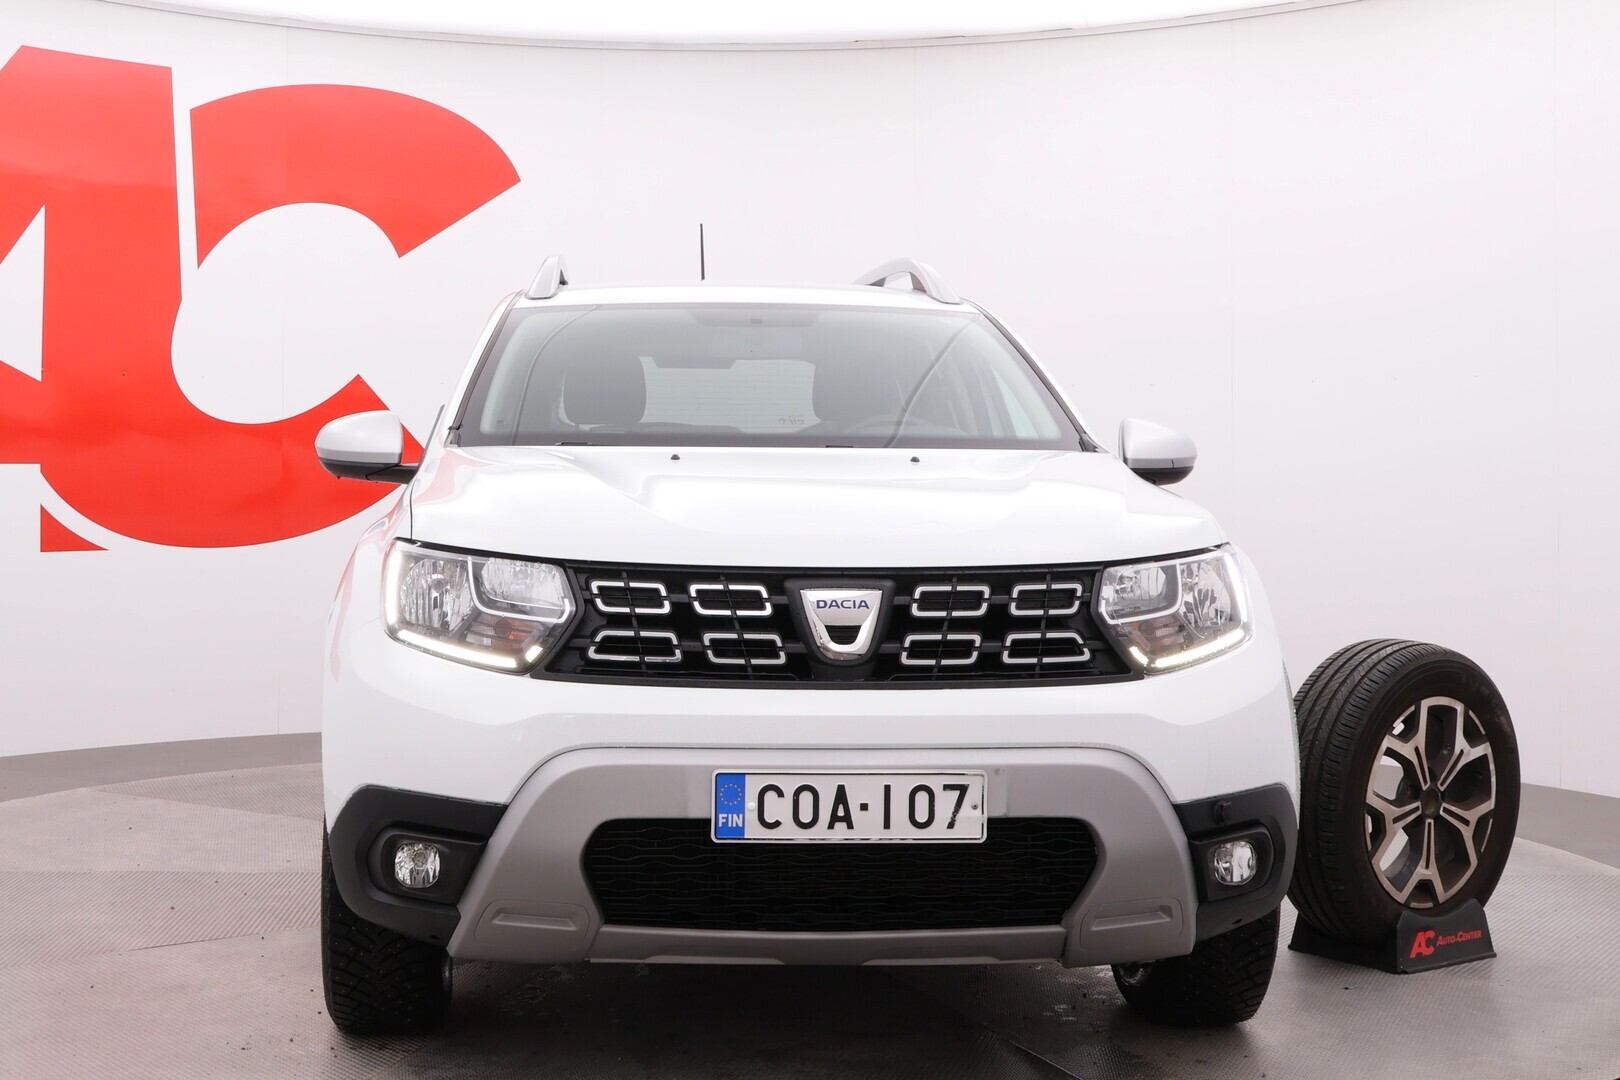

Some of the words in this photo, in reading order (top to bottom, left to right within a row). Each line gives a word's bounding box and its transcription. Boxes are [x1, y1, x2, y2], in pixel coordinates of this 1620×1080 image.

[816, 599, 870, 610] DACIA
[757, 783, 970, 830] COA-107
[718, 813, 743, 828] FIN
[1409, 929, 1436, 959] AC
